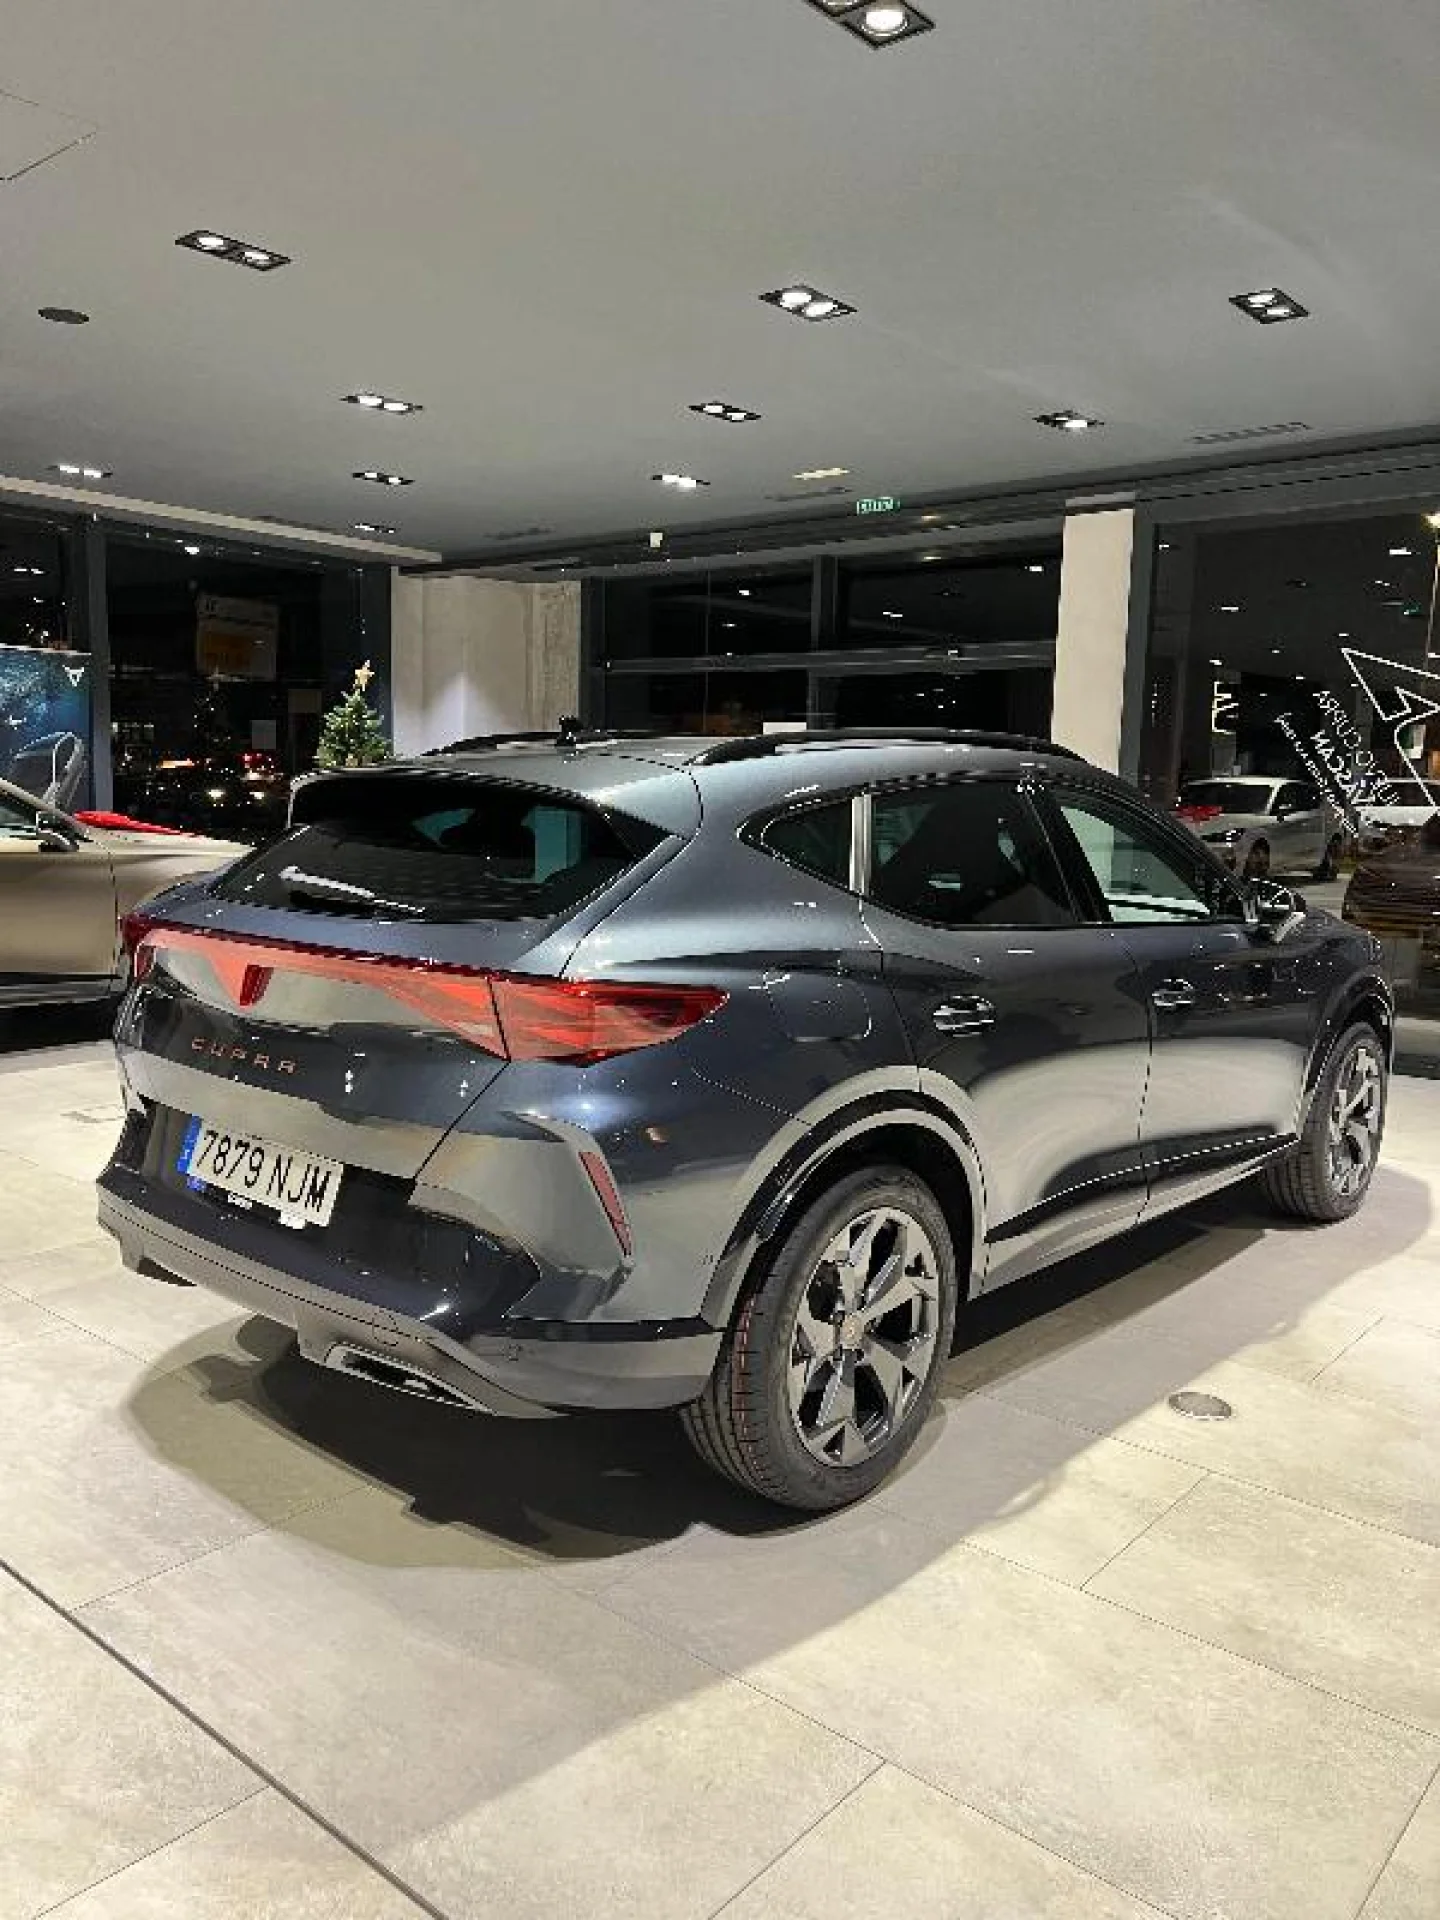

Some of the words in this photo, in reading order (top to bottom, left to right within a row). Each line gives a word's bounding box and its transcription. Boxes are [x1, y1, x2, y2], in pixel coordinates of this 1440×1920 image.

[192, 1037, 296, 1074] CUPRA
[196, 1129, 265, 1188] 7879
[266, 1153, 331, 1213] NJM
